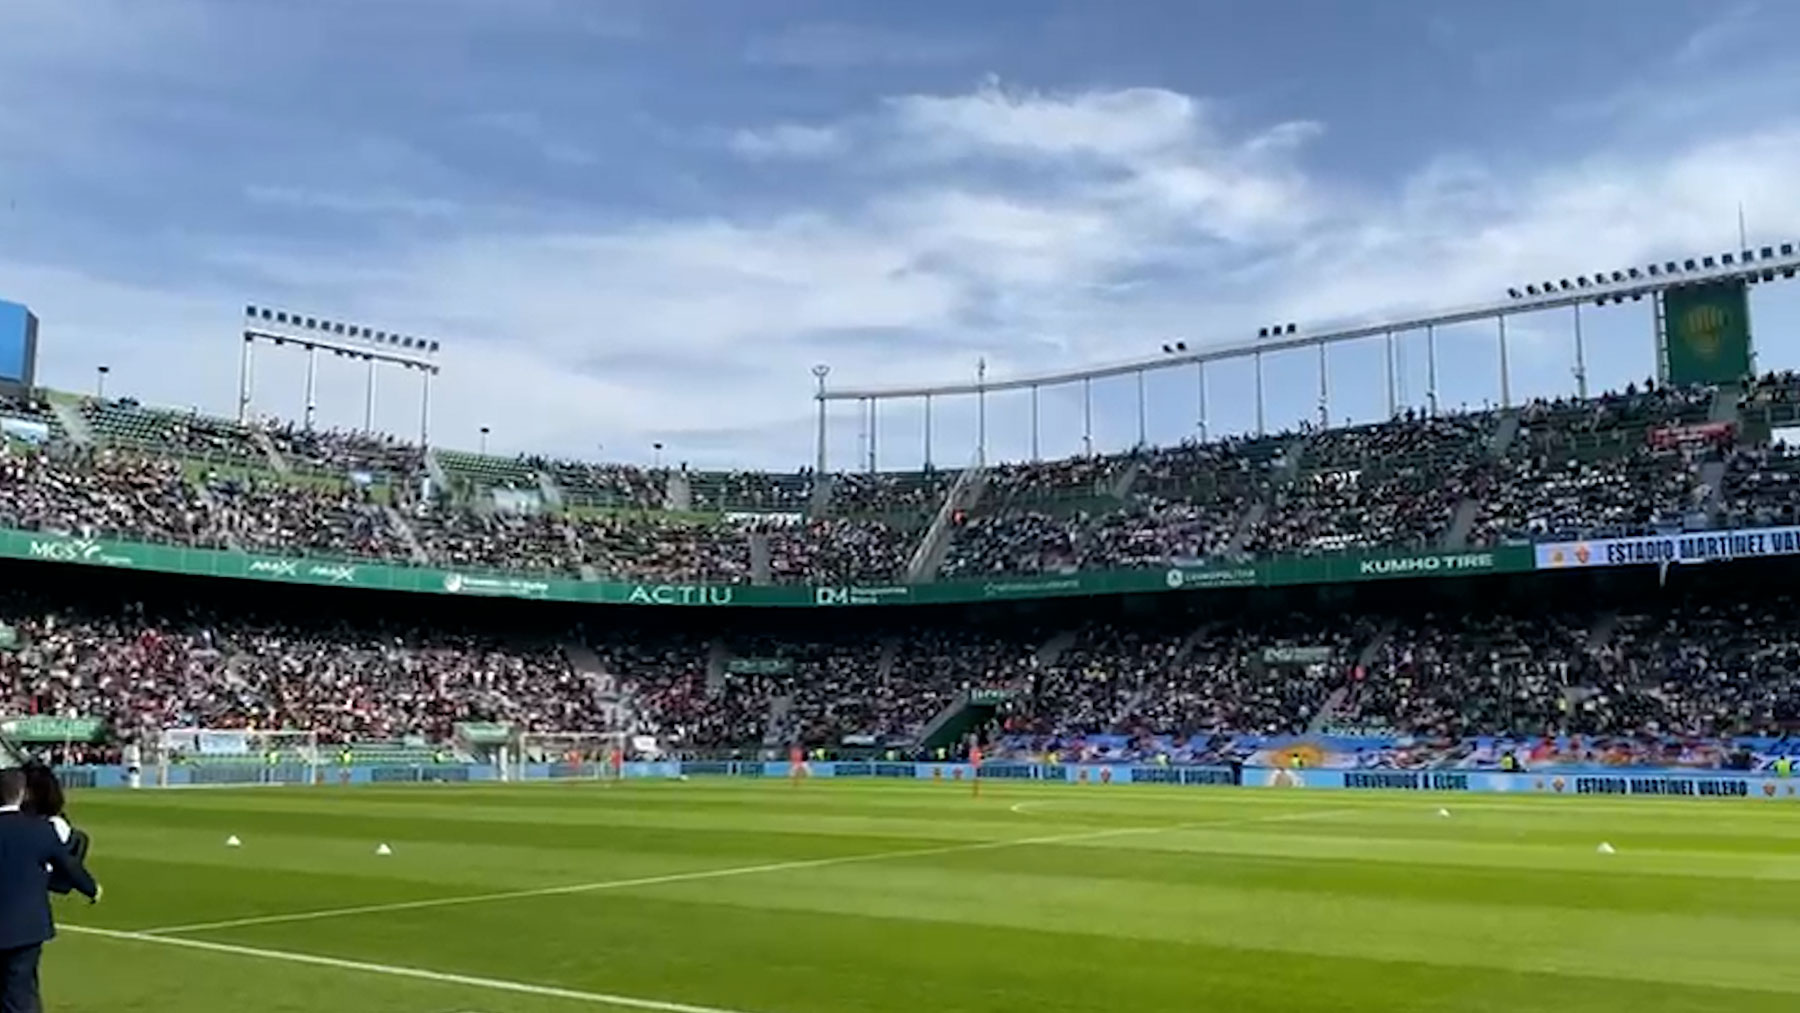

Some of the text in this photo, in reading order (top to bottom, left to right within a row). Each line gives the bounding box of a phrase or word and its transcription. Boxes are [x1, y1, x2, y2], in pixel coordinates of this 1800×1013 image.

[30, 541, 77, 560] MGS
[1608, 539, 1674, 563] ESTADIO
[1361, 554, 1494, 574] KUMHO TIRE
[628, 585, 733, 605] ACTIU
[1576, 777, 1627, 795] ESTADIO
[1699, 780, 1748, 796] VALERO
